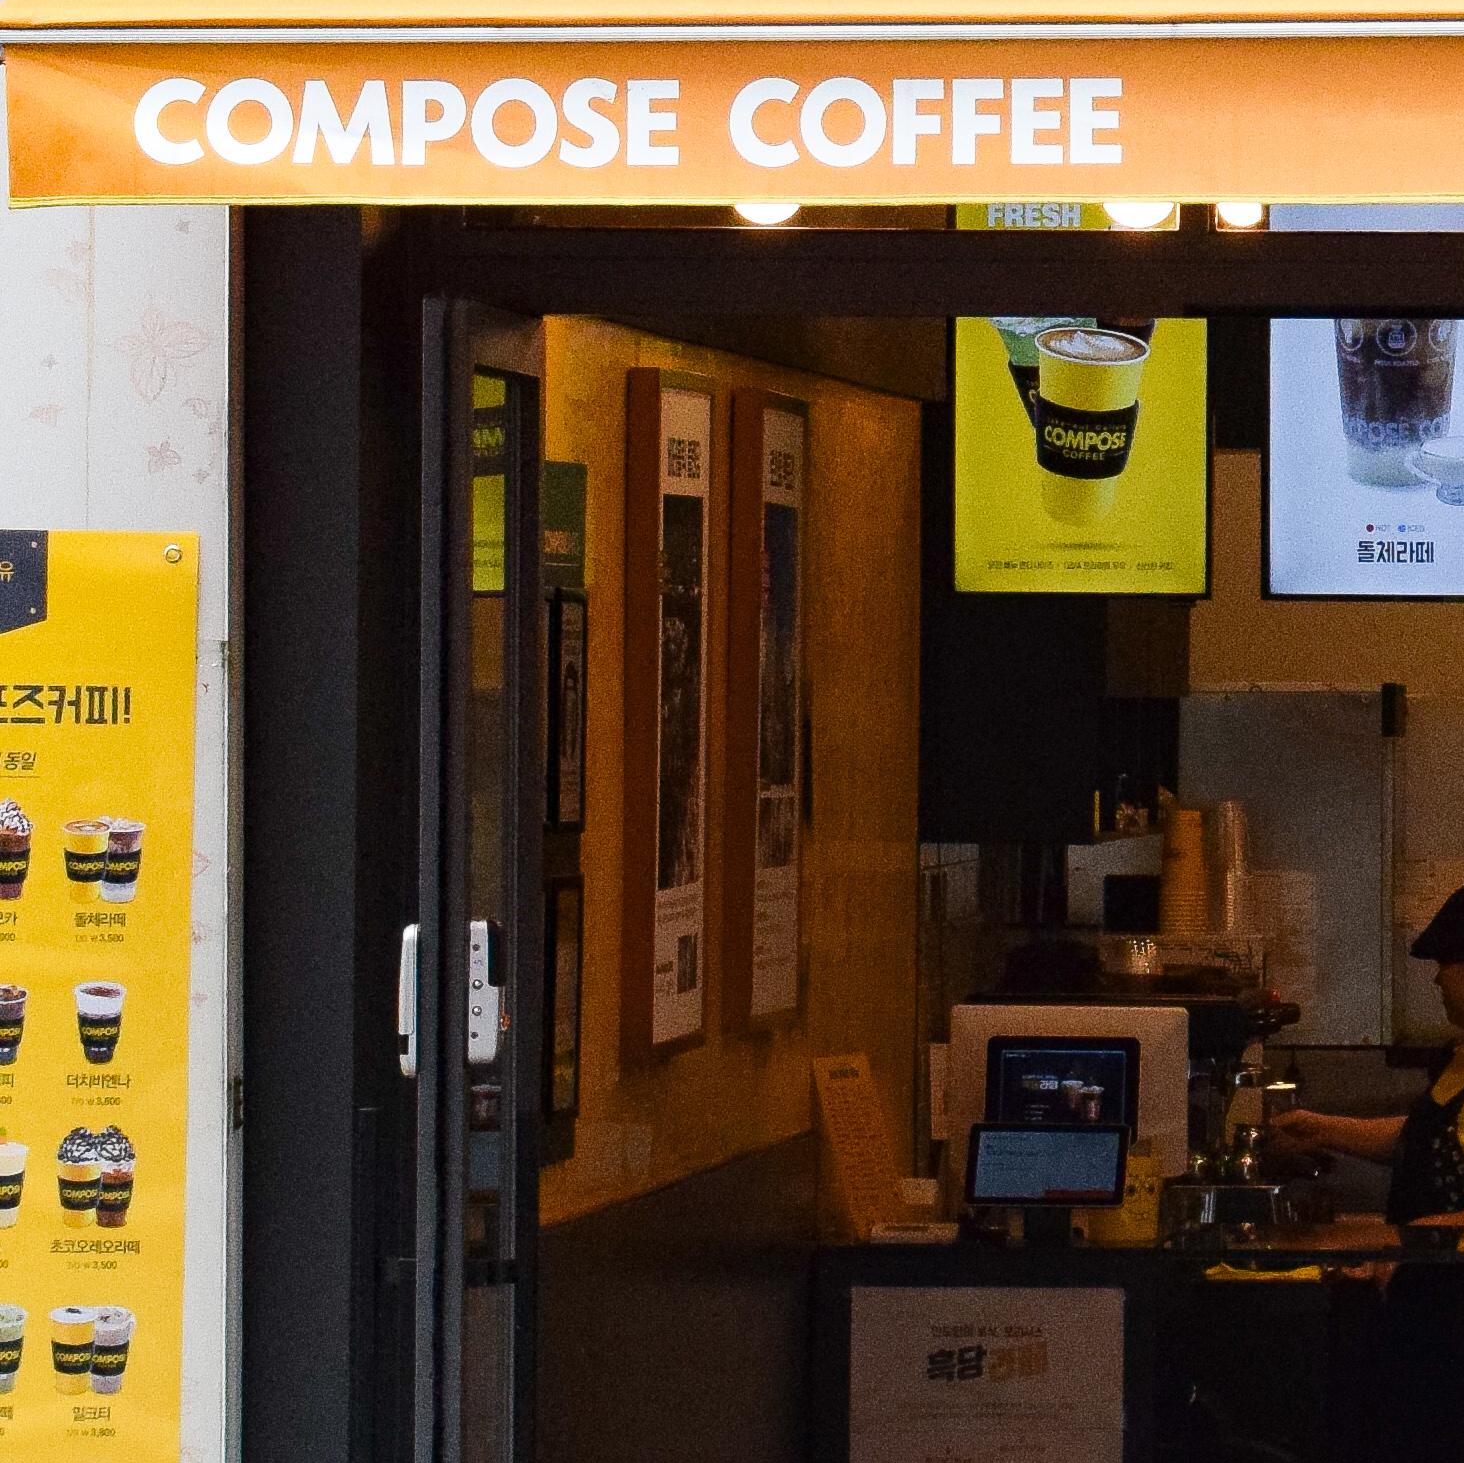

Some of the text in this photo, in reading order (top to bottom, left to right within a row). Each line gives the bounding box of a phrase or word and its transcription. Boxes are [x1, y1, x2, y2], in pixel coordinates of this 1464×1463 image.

[133, 77, 1123, 168] COMPOSE COFFEE
[987, 203, 1081, 228] FRESH
[1044, 425, 1126, 450] COMPOSE
[1063, 449, 1105, 460] COFFEE
[1357, 541, 1434, 563] 돌체라떼
[0, 685, 131, 724] 즈커피!
